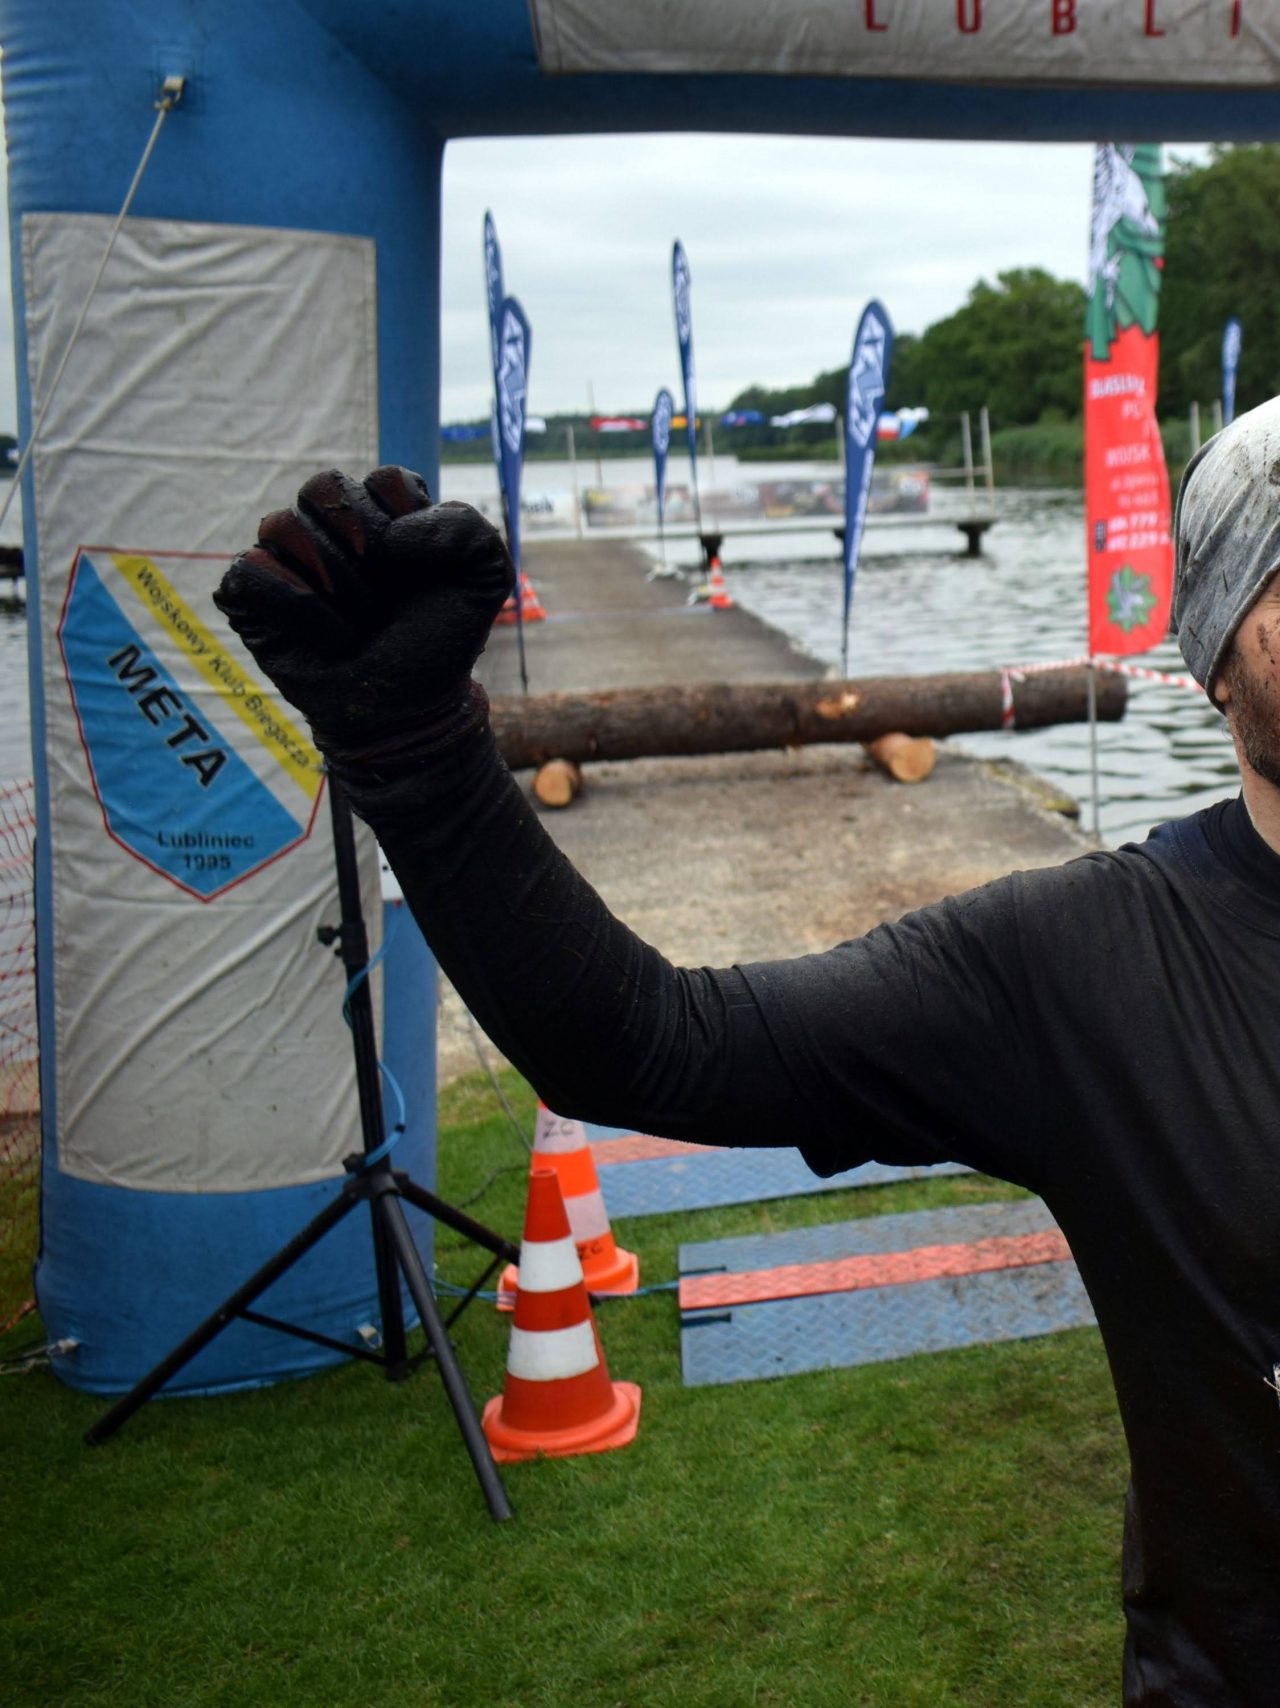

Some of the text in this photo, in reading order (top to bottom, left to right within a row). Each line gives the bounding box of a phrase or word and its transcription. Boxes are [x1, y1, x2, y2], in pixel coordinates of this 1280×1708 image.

[136, 565, 208, 656] Wojskowy
[209, 654, 246, 698] Klub
[107, 643, 228, 788] META
[157, 830, 255, 849] Lubliniec
